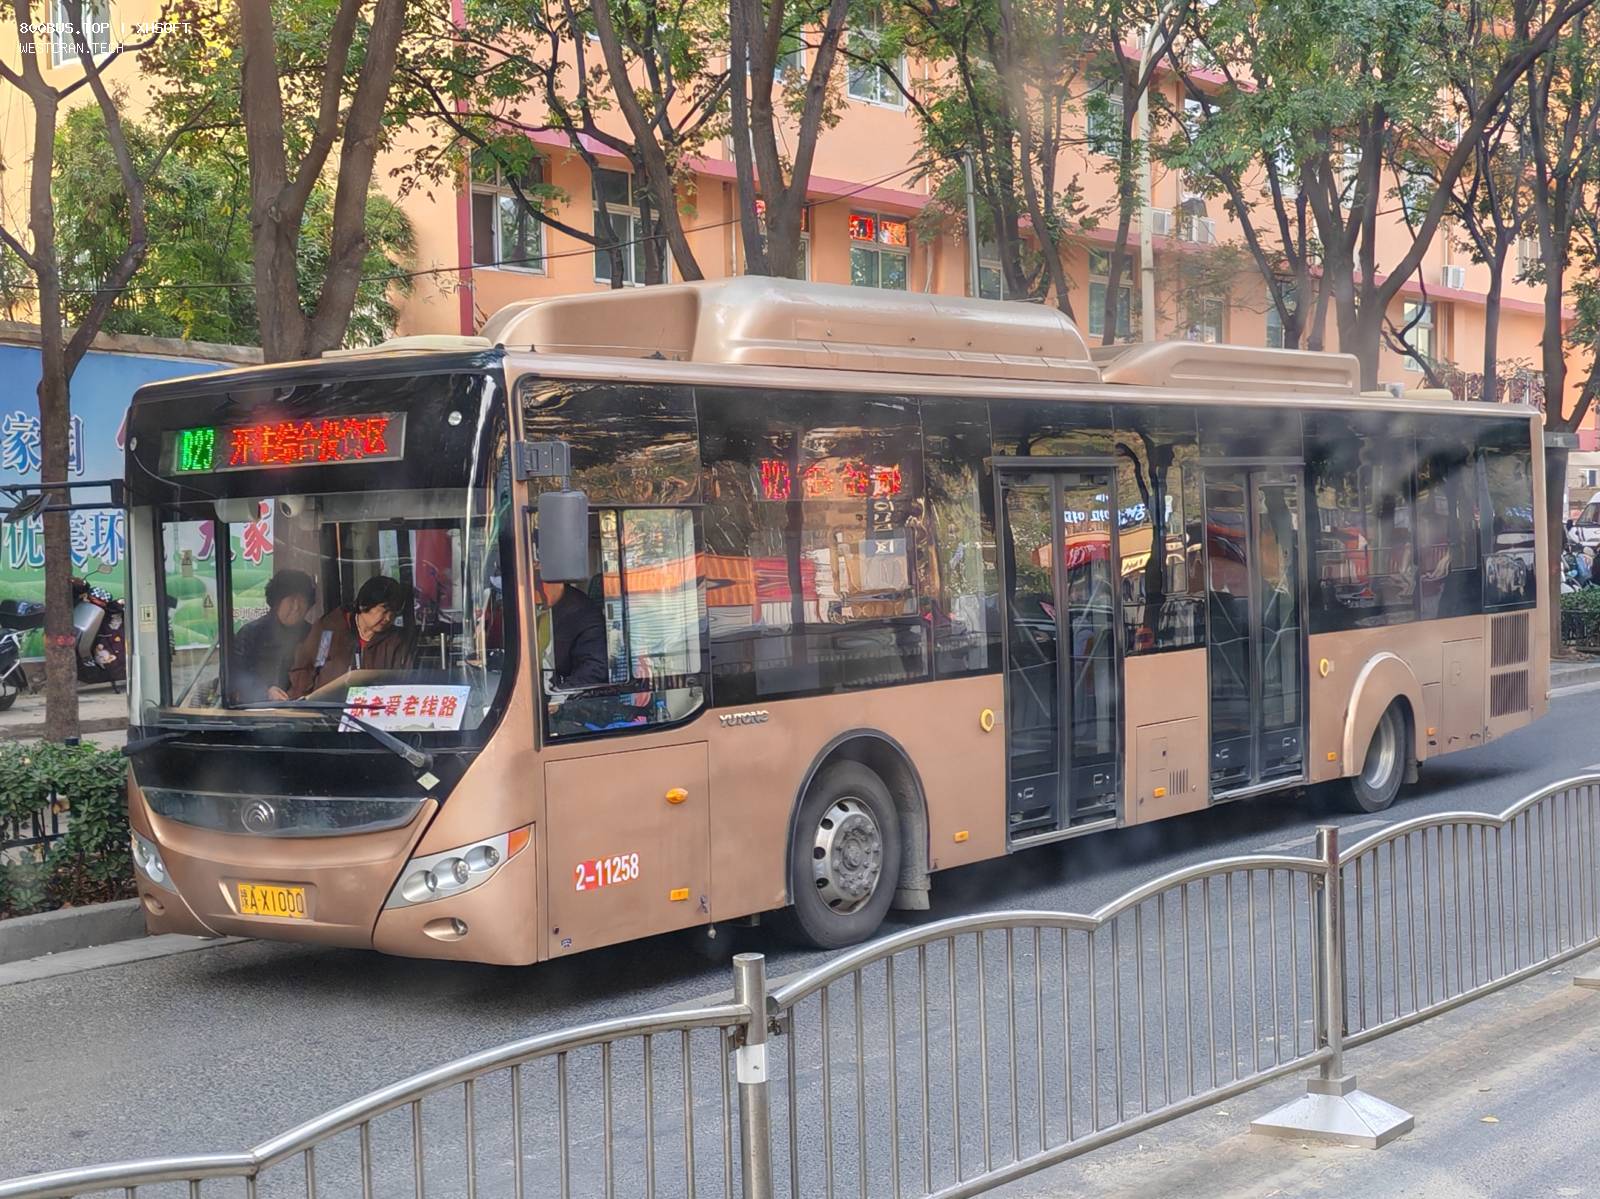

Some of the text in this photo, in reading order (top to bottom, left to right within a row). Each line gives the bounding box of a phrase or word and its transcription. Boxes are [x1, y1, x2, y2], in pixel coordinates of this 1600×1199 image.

[350, 694, 458, 718] 敬老爱老线路
[719, 710, 769, 728] YUTONG
[575, 853, 640, 891] 2-11258
